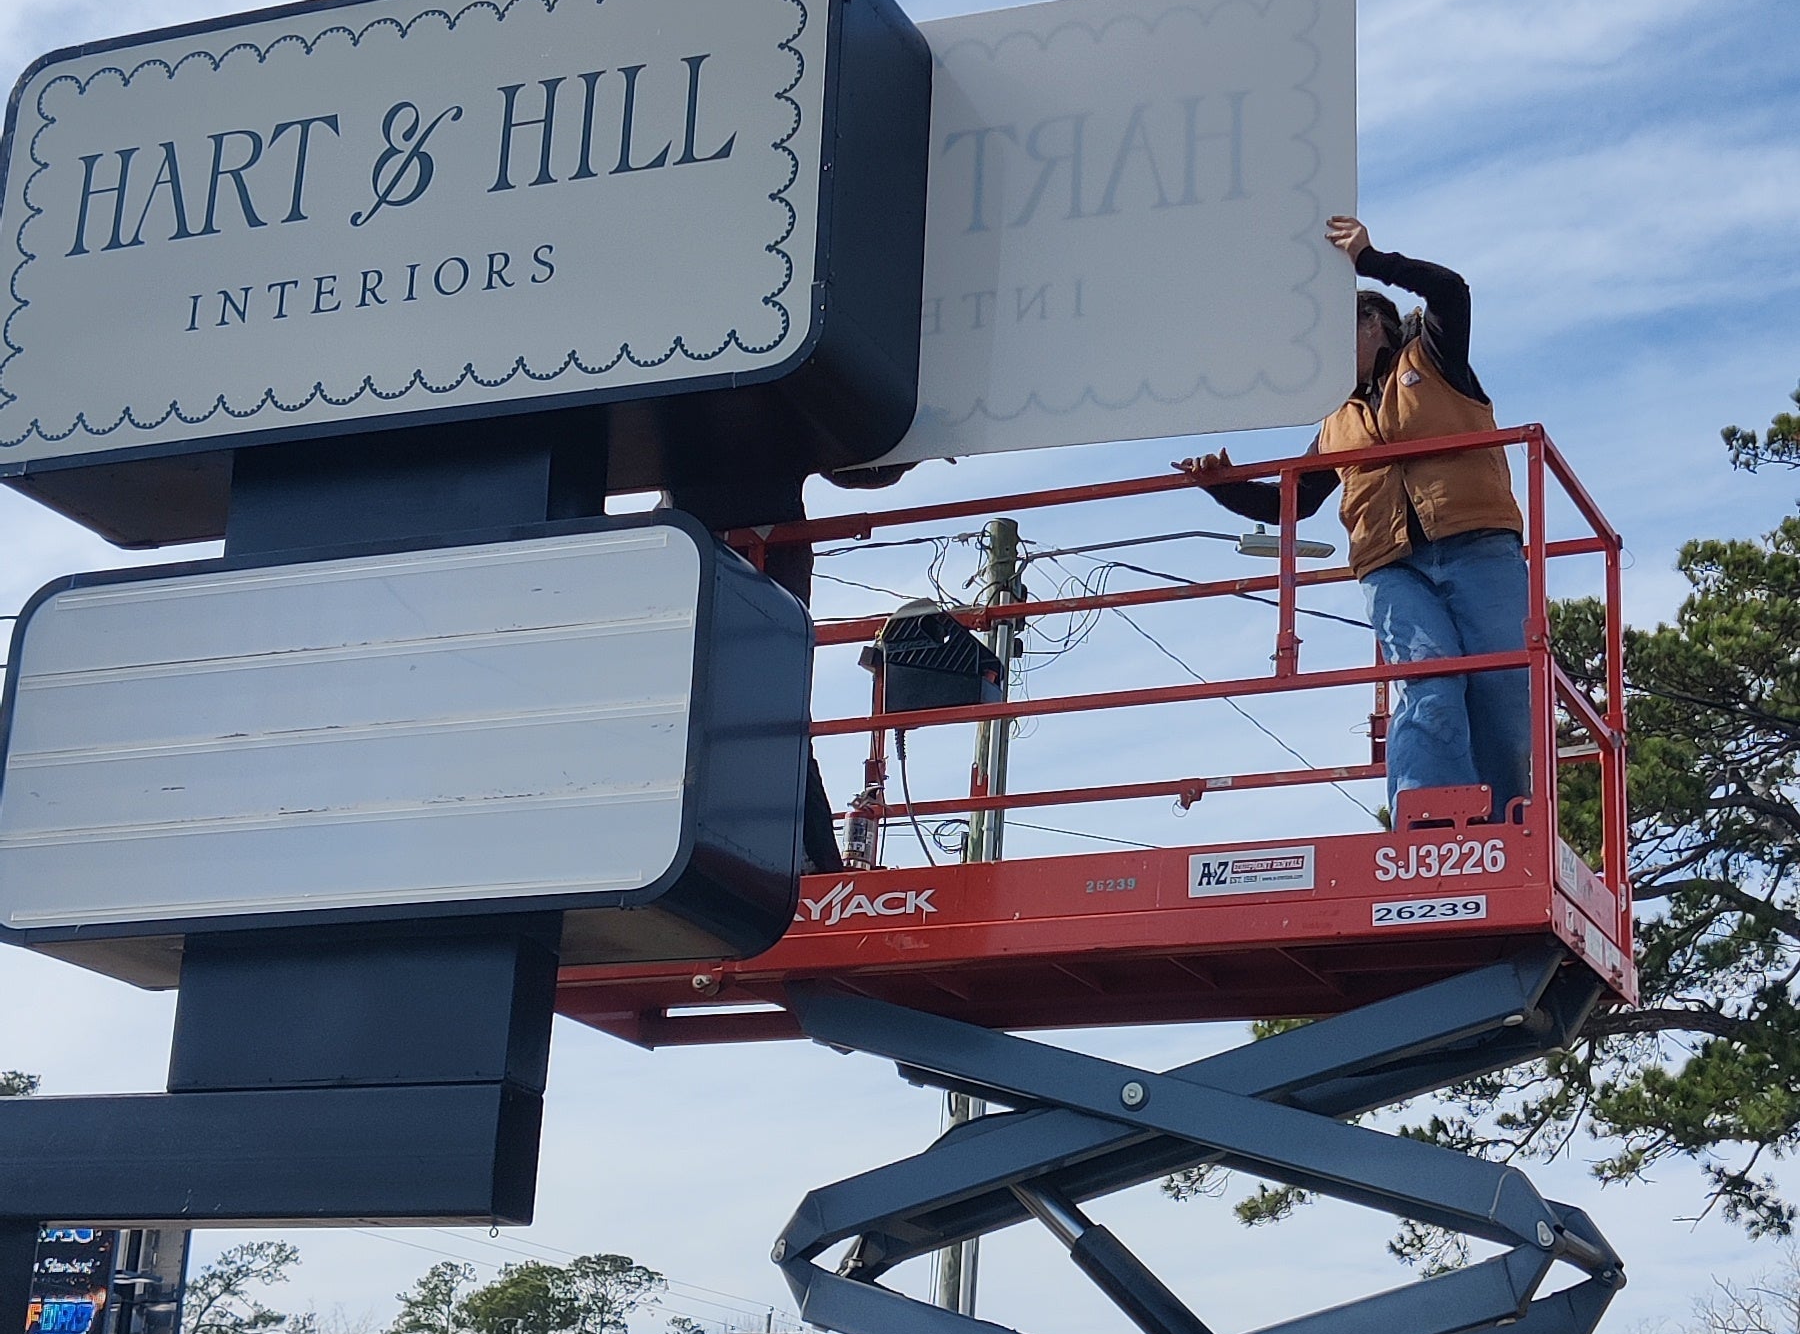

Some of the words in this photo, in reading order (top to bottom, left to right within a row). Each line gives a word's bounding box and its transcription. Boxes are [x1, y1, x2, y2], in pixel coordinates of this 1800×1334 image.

[65, 114, 340, 258] HART
[349, 101, 463, 227] &
[488, 54, 737, 195] HILL
[184, 244, 556, 333] INTERIORS
[1375, 839, 1505, 881] SJ3226
[794, 881, 938, 926] YJACK
[1086, 878, 1136, 893] 26239
[1375, 901, 1481, 921] 26239
